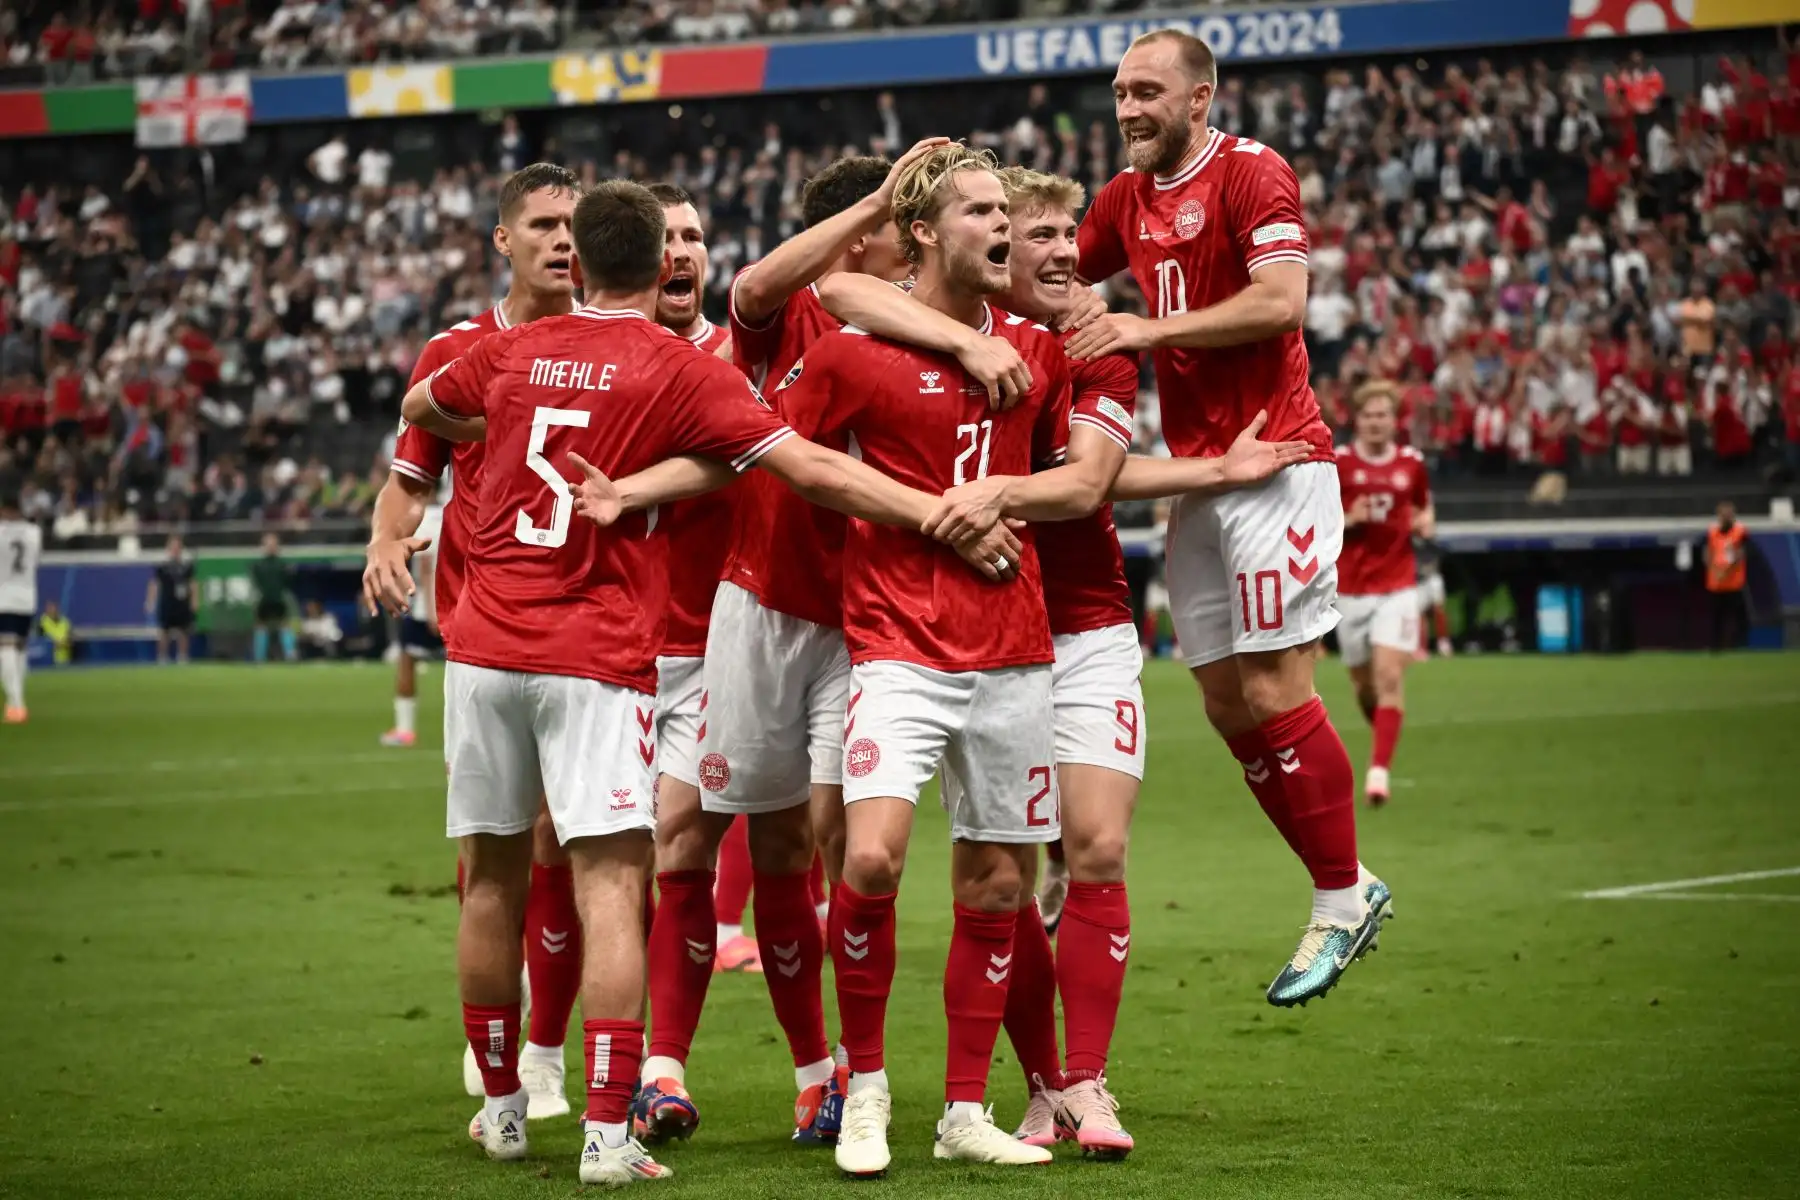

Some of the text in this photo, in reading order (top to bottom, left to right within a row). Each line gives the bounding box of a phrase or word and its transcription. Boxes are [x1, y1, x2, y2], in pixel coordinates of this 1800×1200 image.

[977, 8, 1342, 74] UEFA EO 2024
[1155, 259, 1187, 319] 10
[529, 357, 617, 391] MÆHLE
[515, 406, 591, 549] 5
[954, 420, 992, 486] 21
[10, 540, 26, 574] 2
[1236, 569, 1283, 632] 10
[851, 750, 872, 765] DBU
[1115, 699, 1138, 756] 9
